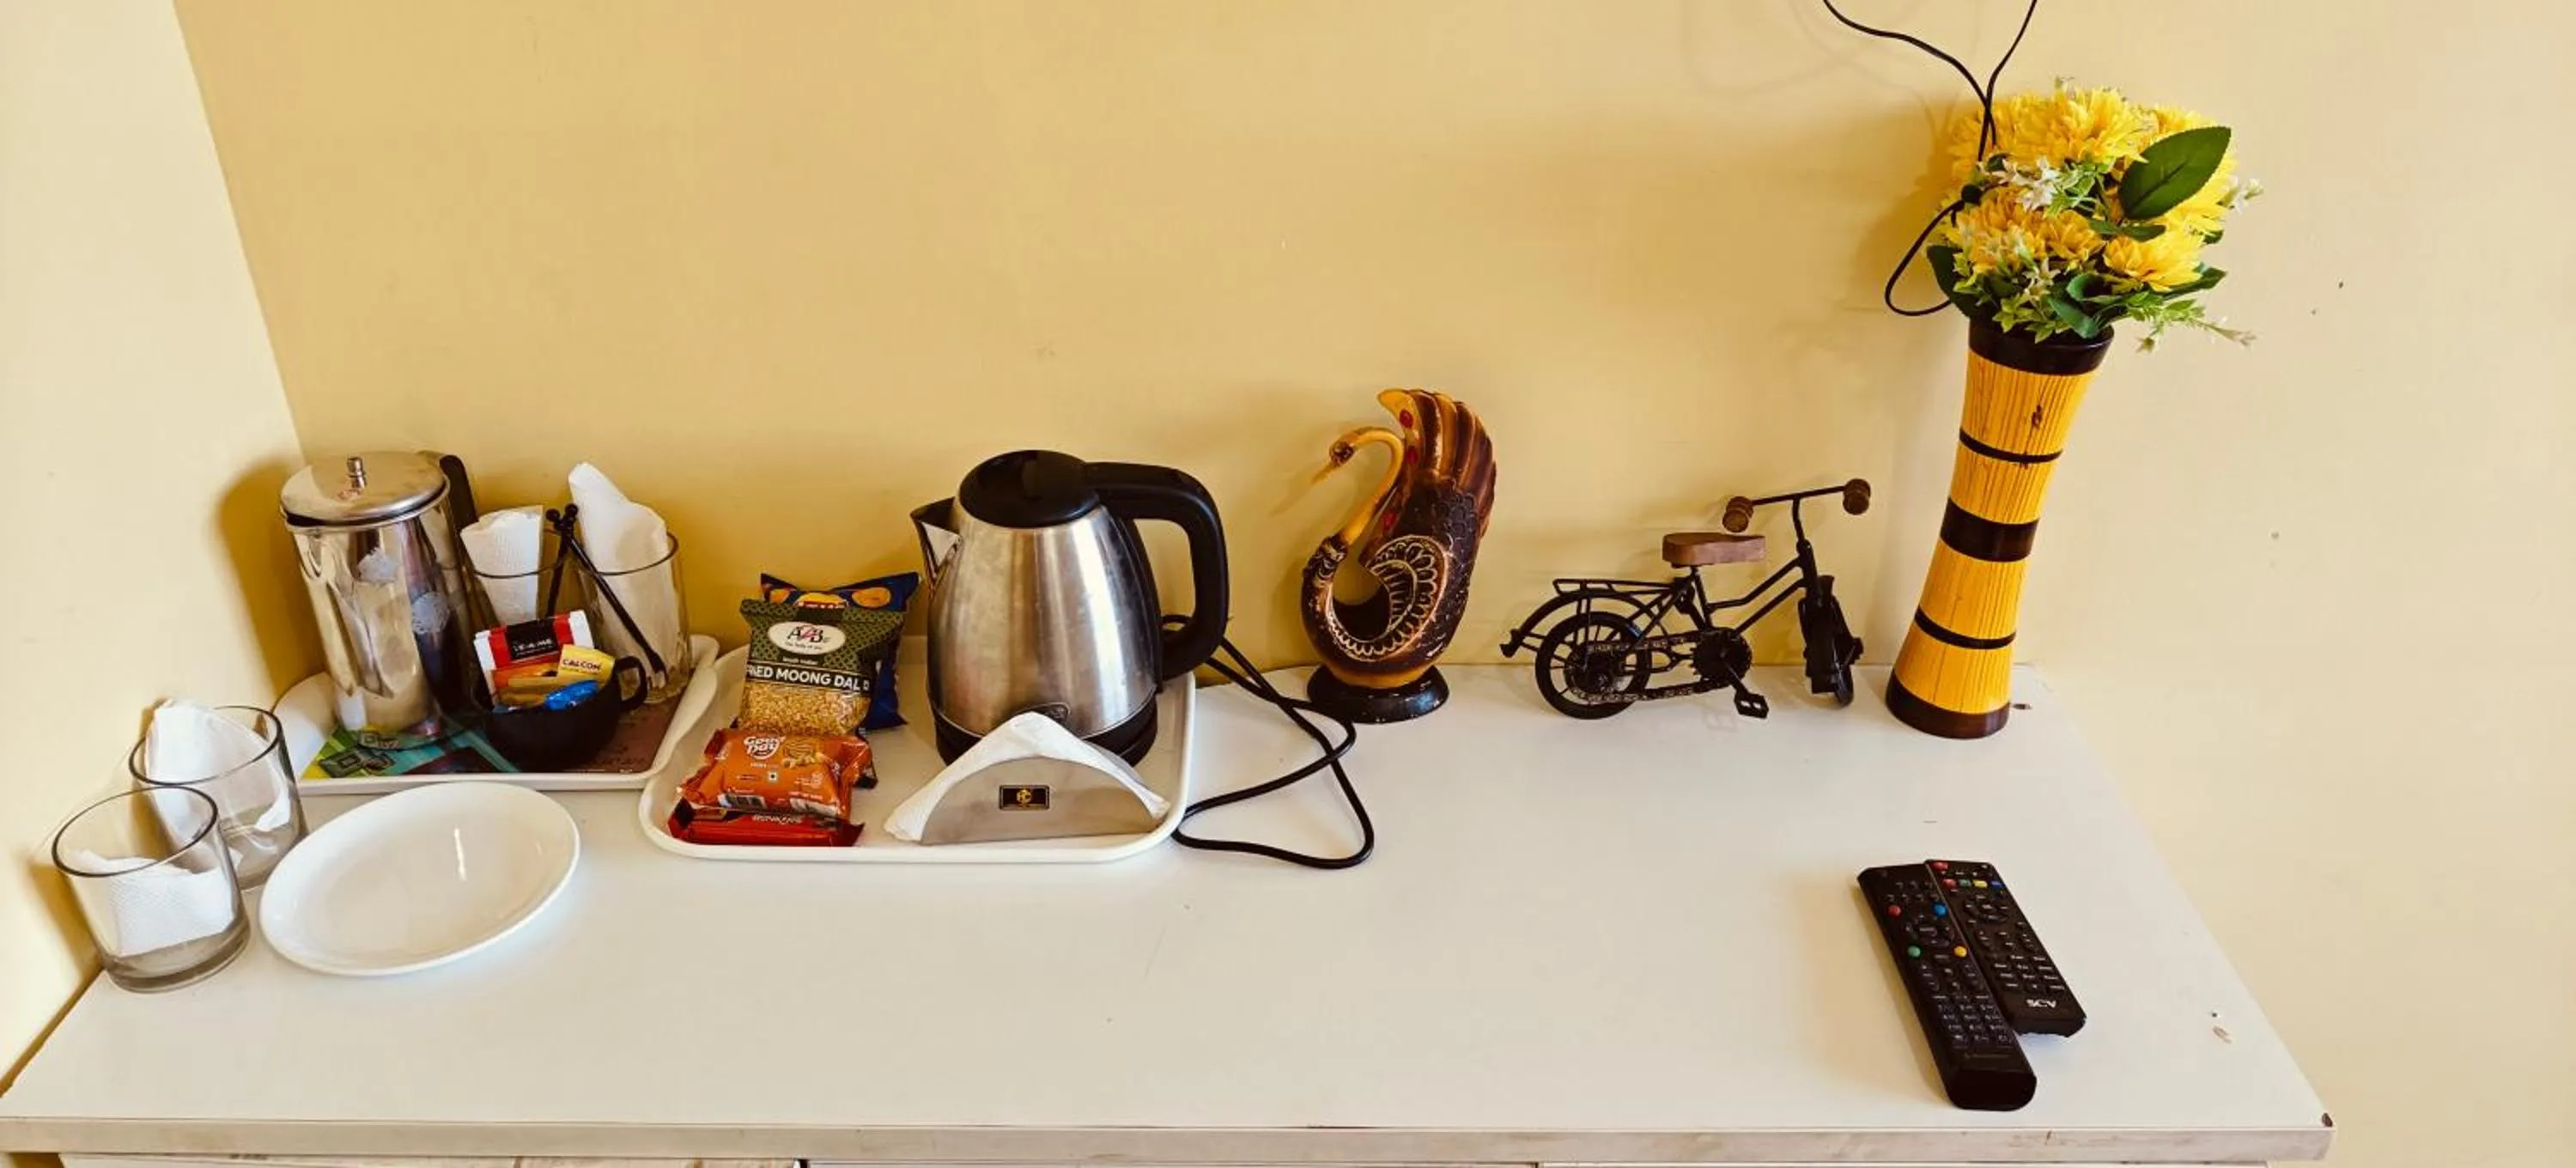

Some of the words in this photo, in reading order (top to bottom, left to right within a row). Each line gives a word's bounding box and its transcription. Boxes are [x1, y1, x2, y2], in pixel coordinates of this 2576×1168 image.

[775, 667, 831, 684] MOONG
[834, 675, 860, 690] DAL
[2026, 999, 2057, 1008] SCV
